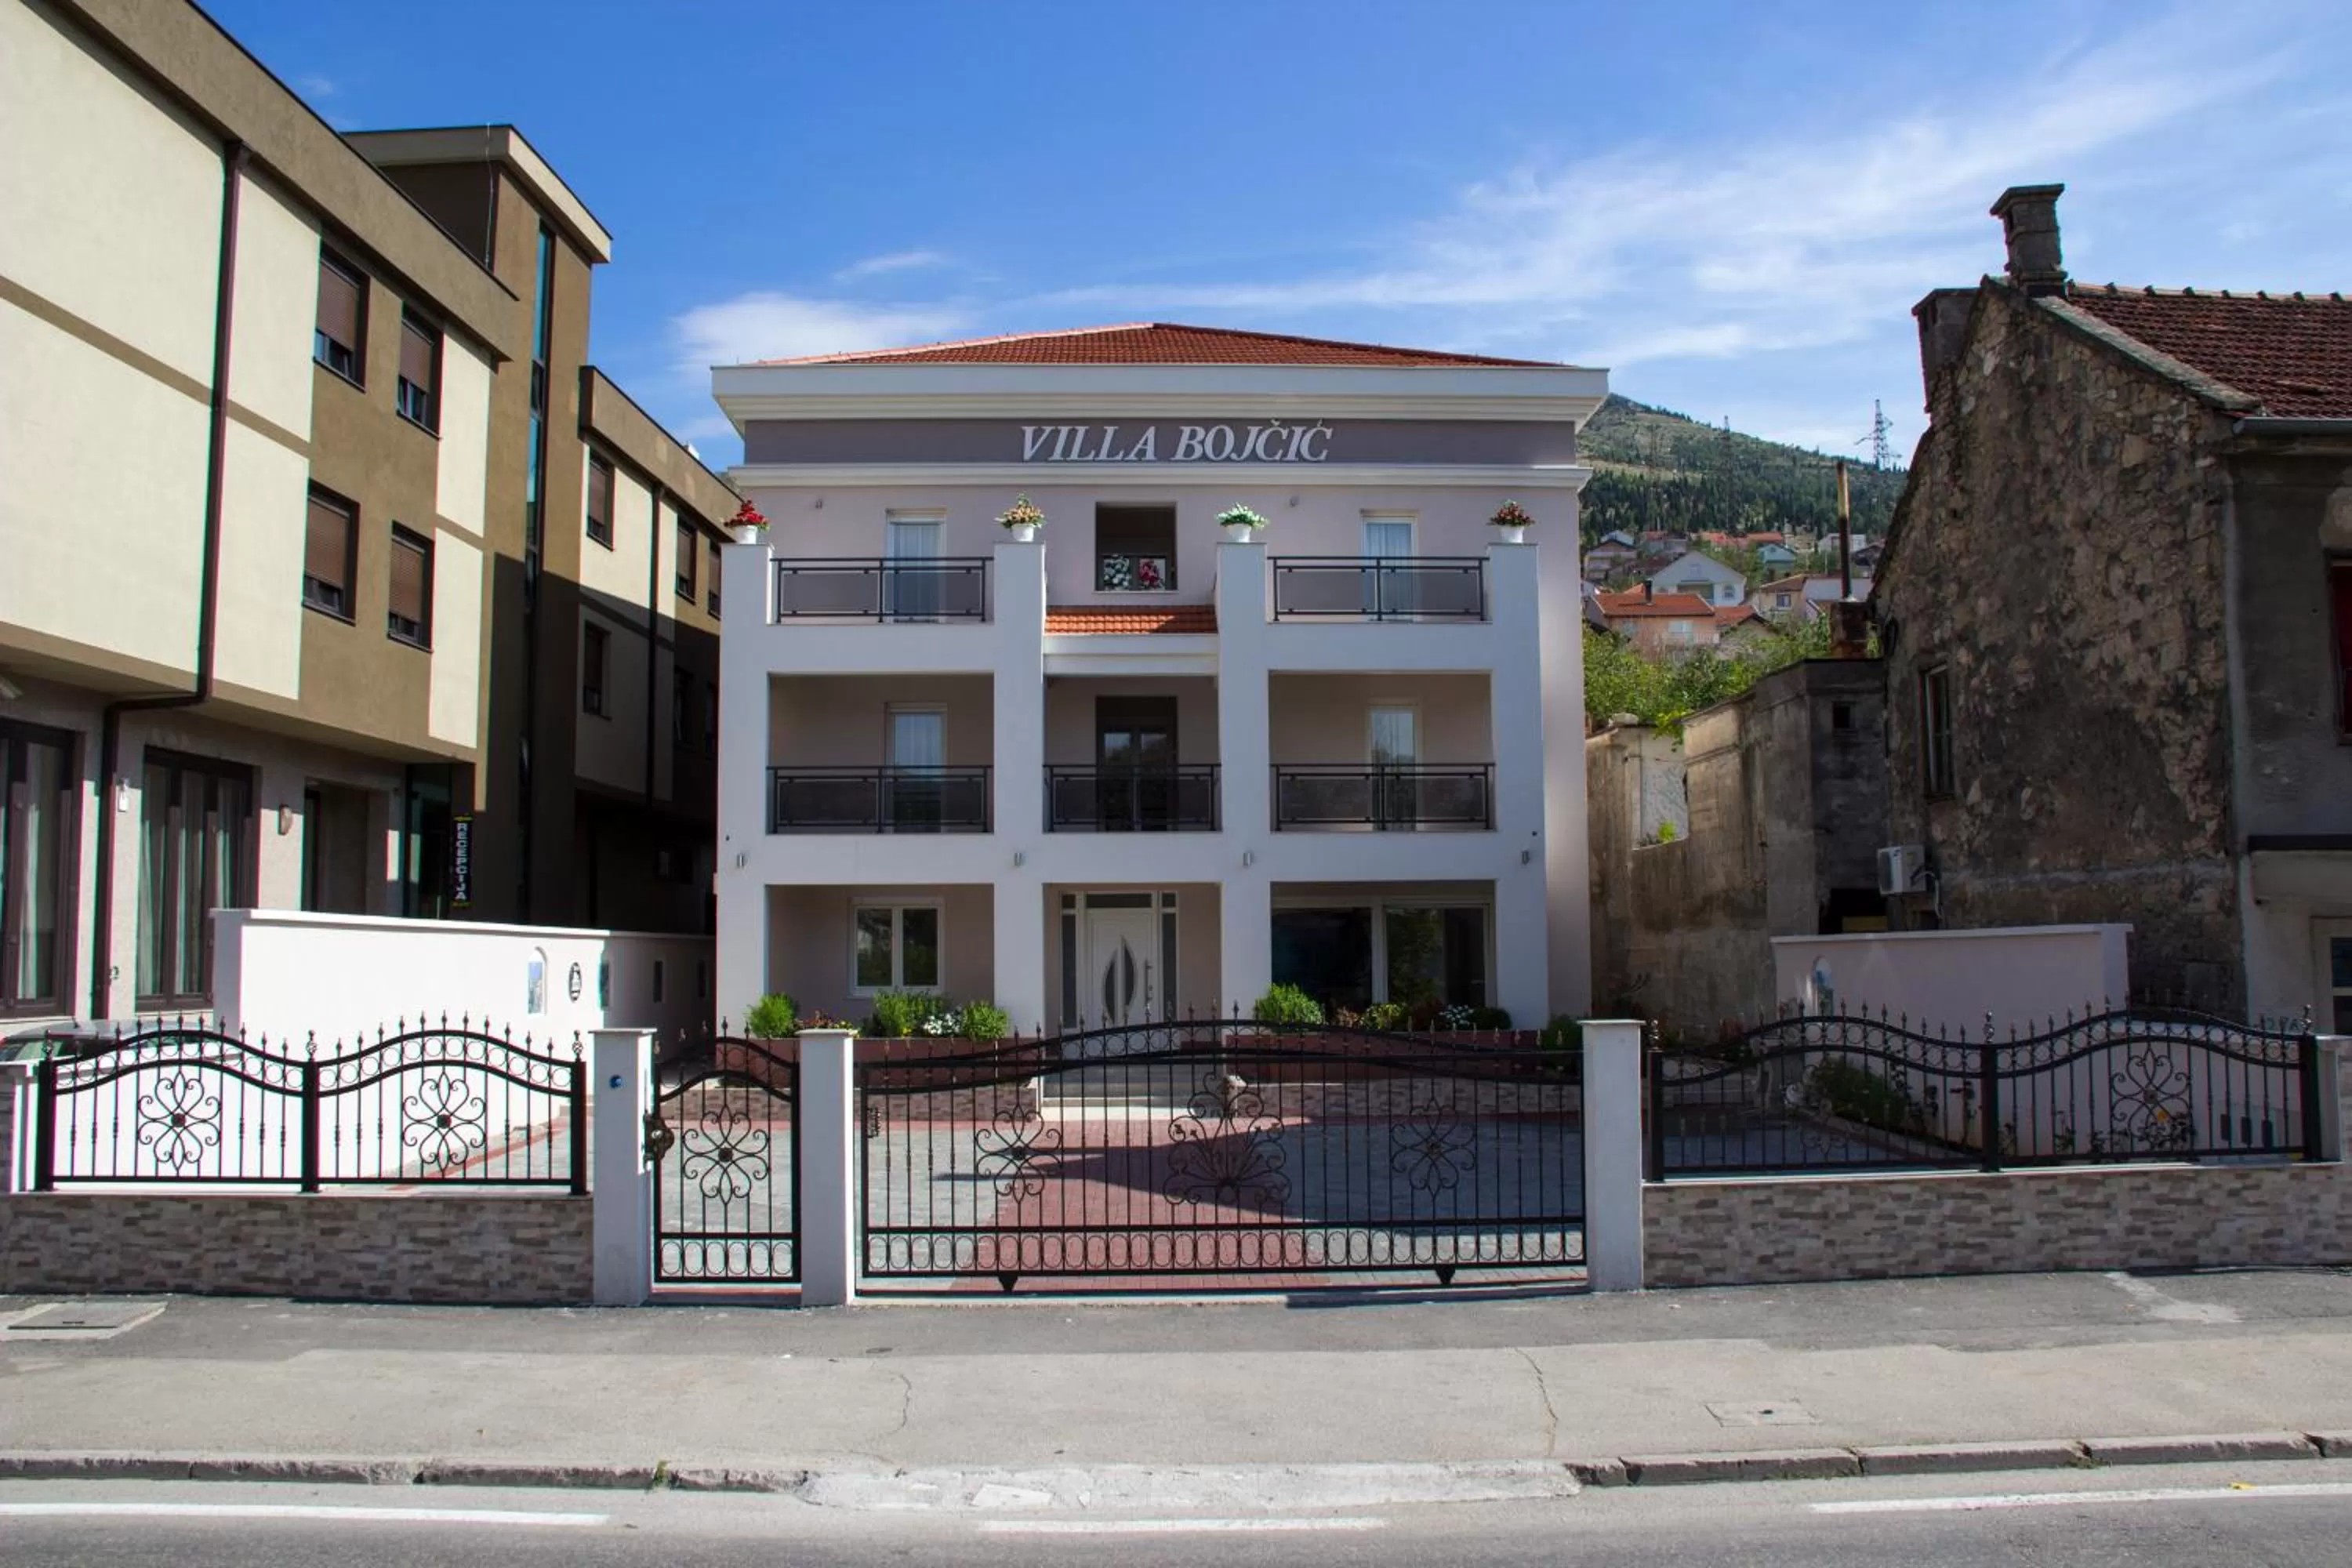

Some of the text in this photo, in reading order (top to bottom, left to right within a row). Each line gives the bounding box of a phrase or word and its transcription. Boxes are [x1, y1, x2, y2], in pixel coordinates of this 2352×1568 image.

[1021, 418, 1333, 461] VILLA BOJČIĆ
[456, 822, 468, 901] RECEPCIJA
